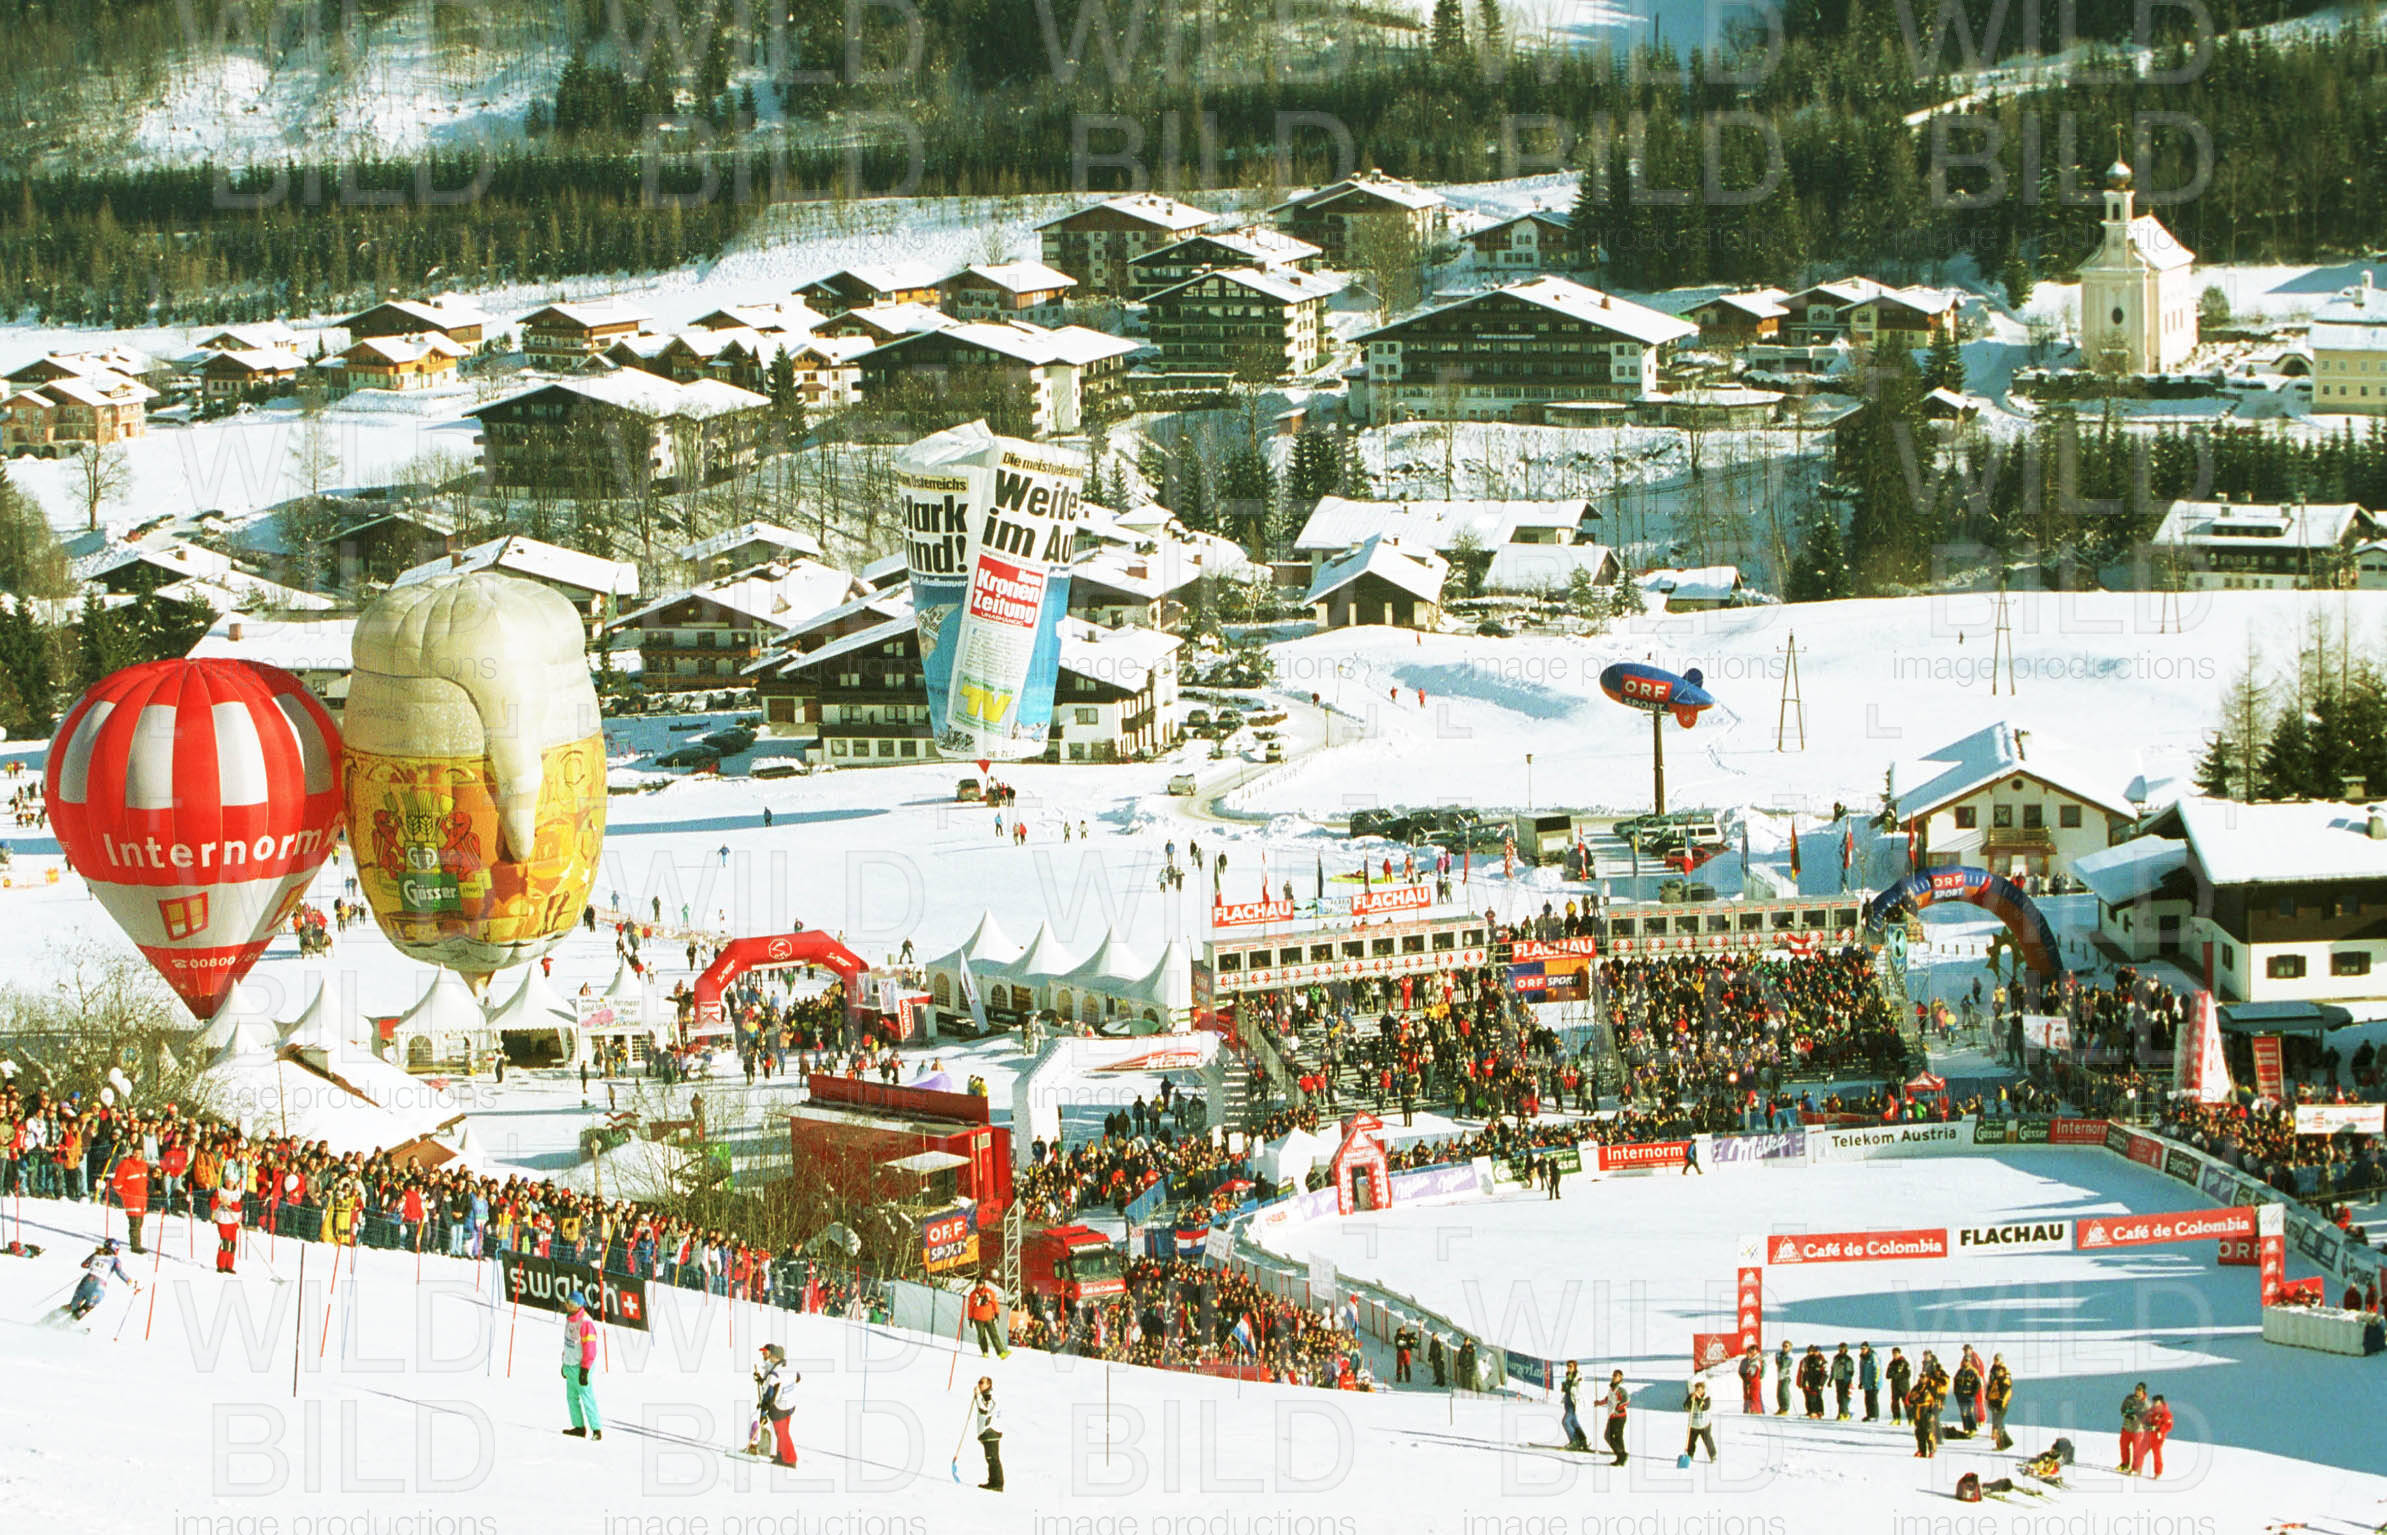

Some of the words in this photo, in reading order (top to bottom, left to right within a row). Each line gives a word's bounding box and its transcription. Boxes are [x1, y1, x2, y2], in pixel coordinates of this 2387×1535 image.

[1003, 452, 1021, 468] Die
[981, 507, 1036, 558] im
[976, 567, 1040, 603] Kronen
[972, 588, 1036, 625] Zeitung
[1624, 681, 1666, 698] ORF
[960, 683, 1013, 723] TV
[1624, 697, 1665, 711] SPORT
[103, 828, 319, 869] Internorm
[403, 878, 457, 903] Gösser
[1933, 875, 1963, 888] ORF
[1353, 888, 1428, 910] FLACHAU
[1214, 902, 1292, 922] FLACHAU
[1513, 938, 1593, 957] FLACHAU
[190, 956, 236, 968] 00800
[1517, 977, 1543, 990] ORF
[1832, 1133, 1894, 1148] Telekom
[1901, 1126, 1957, 1142] Austria
[1607, 1144, 1684, 1161] Internorm
[1728, 1134, 1791, 1164] Milka
[1960, 1223, 2064, 1246] FLACHAU
[2112, 1225, 2149, 1241] Café
[2153, 1222, 2171, 1238] de
[2175, 1217, 2250, 1237] Colombia
[1803, 1241, 1840, 1258] Café
[1844, 1241, 1863, 1257] de
[1866, 1237, 1943, 1256] Colombia
[510, 1267, 620, 1316] swatch
